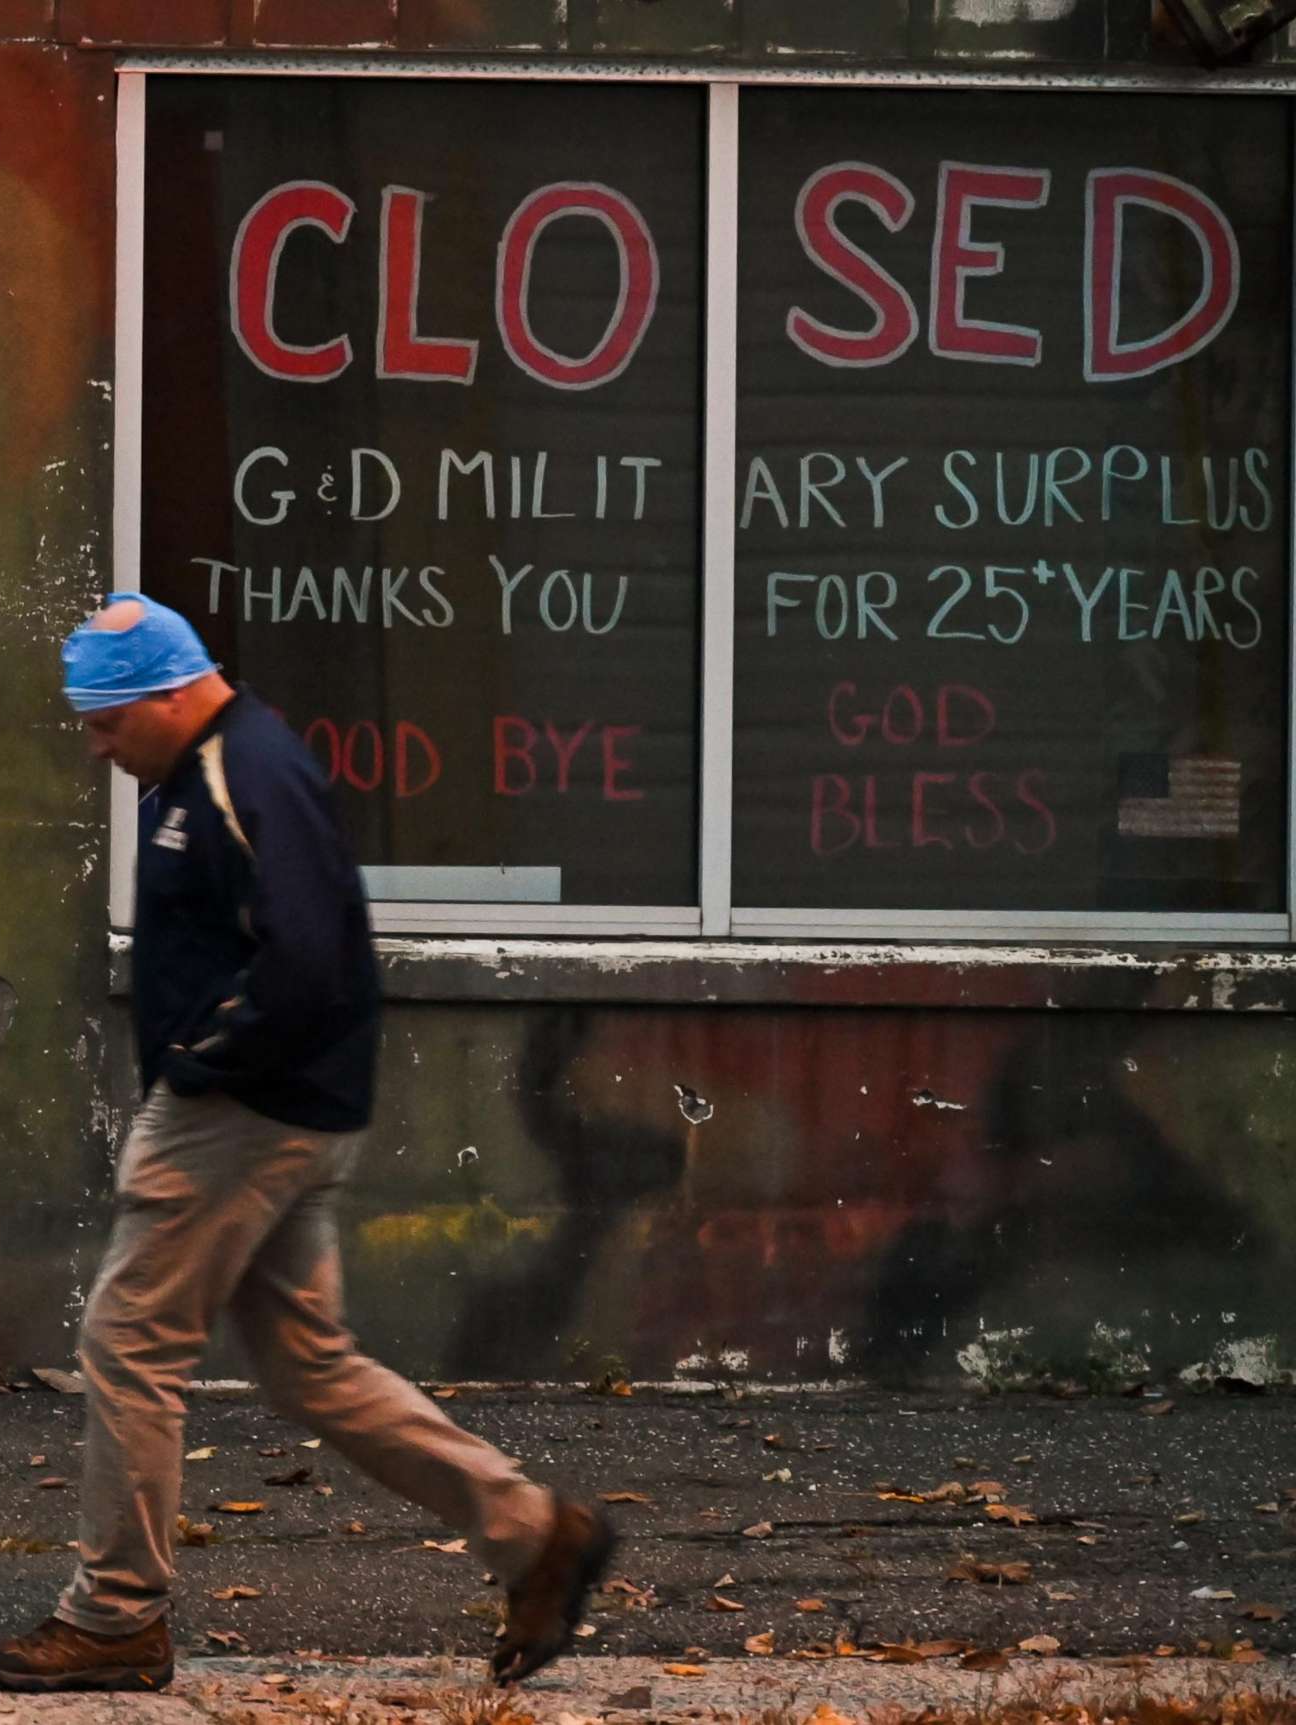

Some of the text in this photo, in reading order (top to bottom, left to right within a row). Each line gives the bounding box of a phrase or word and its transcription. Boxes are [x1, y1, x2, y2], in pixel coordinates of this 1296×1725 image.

[934, 445, 1273, 532] SURPLUS
[190, 557, 454, 628] THANKS
[488, 555, 628, 634] YOU
[765, 571, 899, 641] FOR
[1061, 562, 1263, 649] YEARS
[272, 704, 645, 800] OOD BYE
[828, 681, 997, 747] GOD
[809, 770, 1058, 854] BLESS
